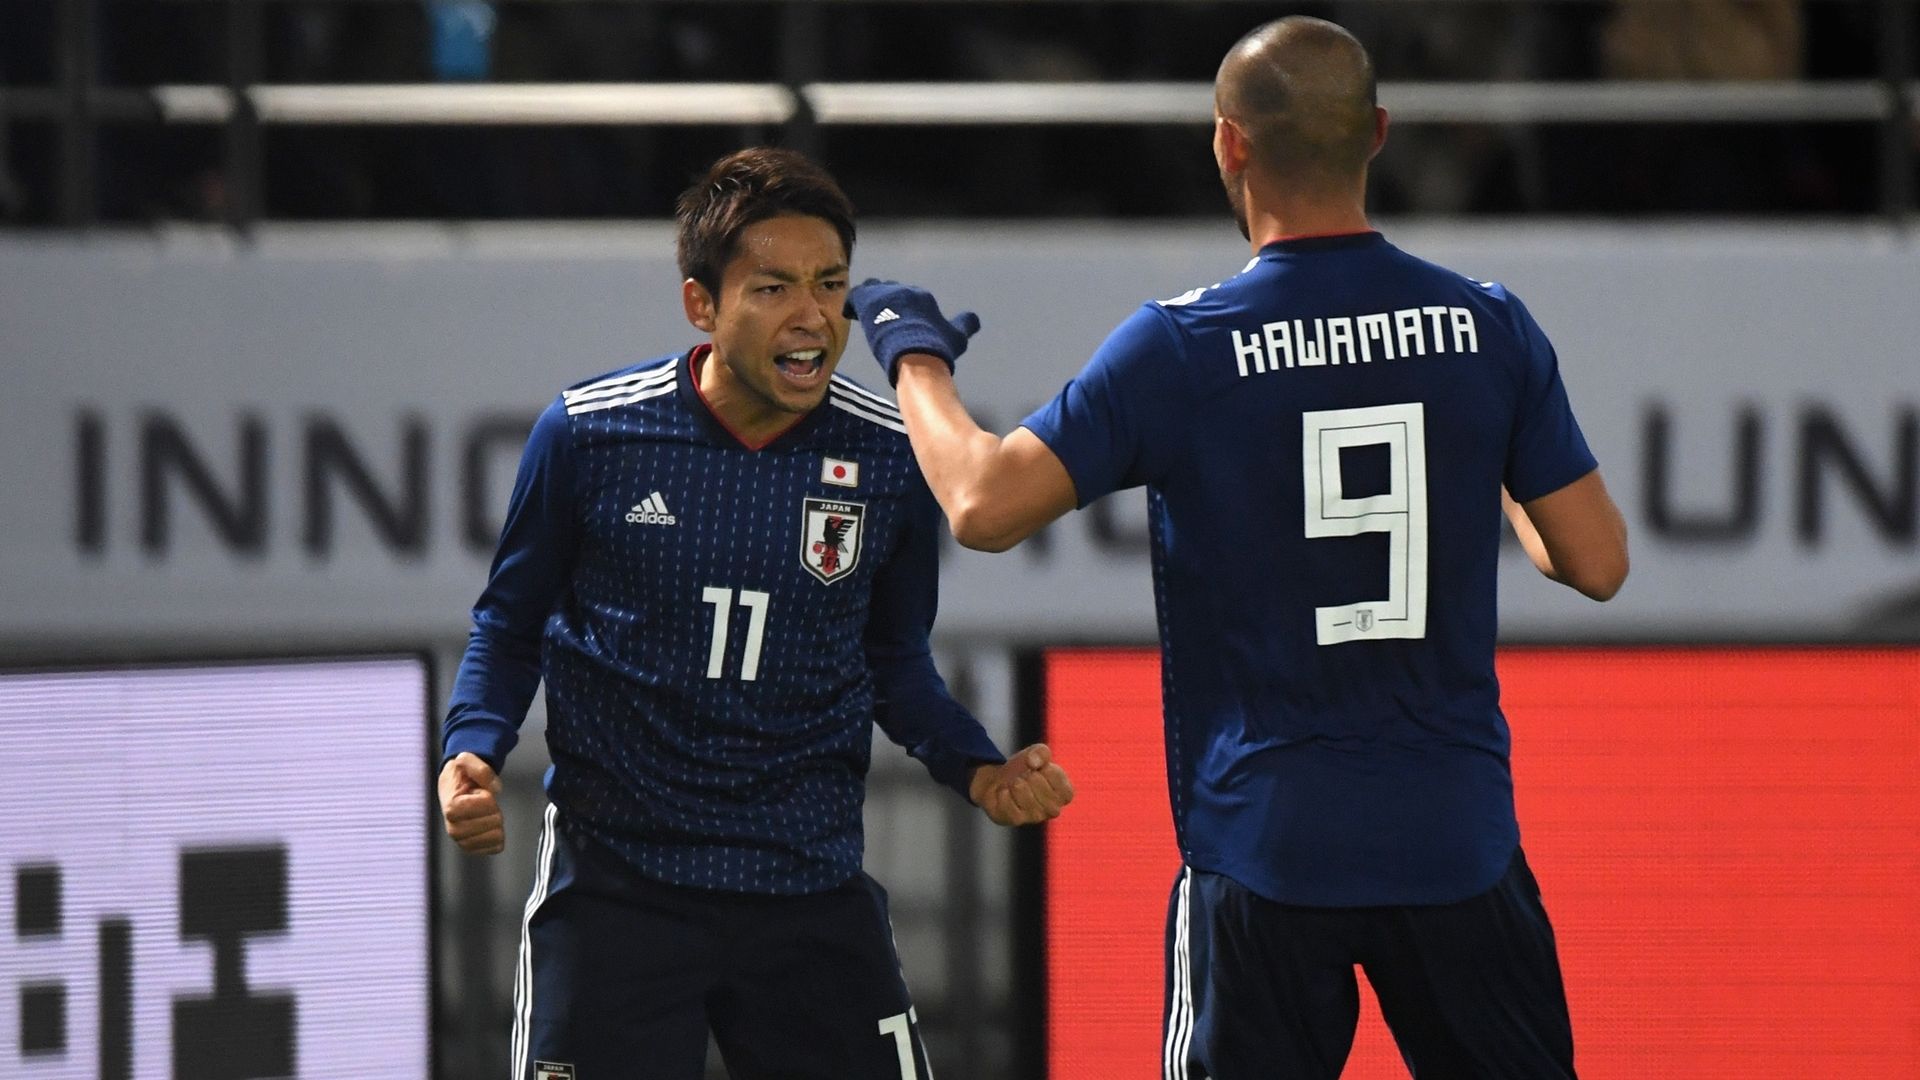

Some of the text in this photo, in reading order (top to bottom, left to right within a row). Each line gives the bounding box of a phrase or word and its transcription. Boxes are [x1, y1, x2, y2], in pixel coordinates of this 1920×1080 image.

[1231, 305, 1479, 377] KAWAMATA
[625, 511, 676, 525] adidas
[820, 503, 851, 512] JAPAN
[1302, 402, 1429, 646] 9
[702, 586, 770, 681] 11
